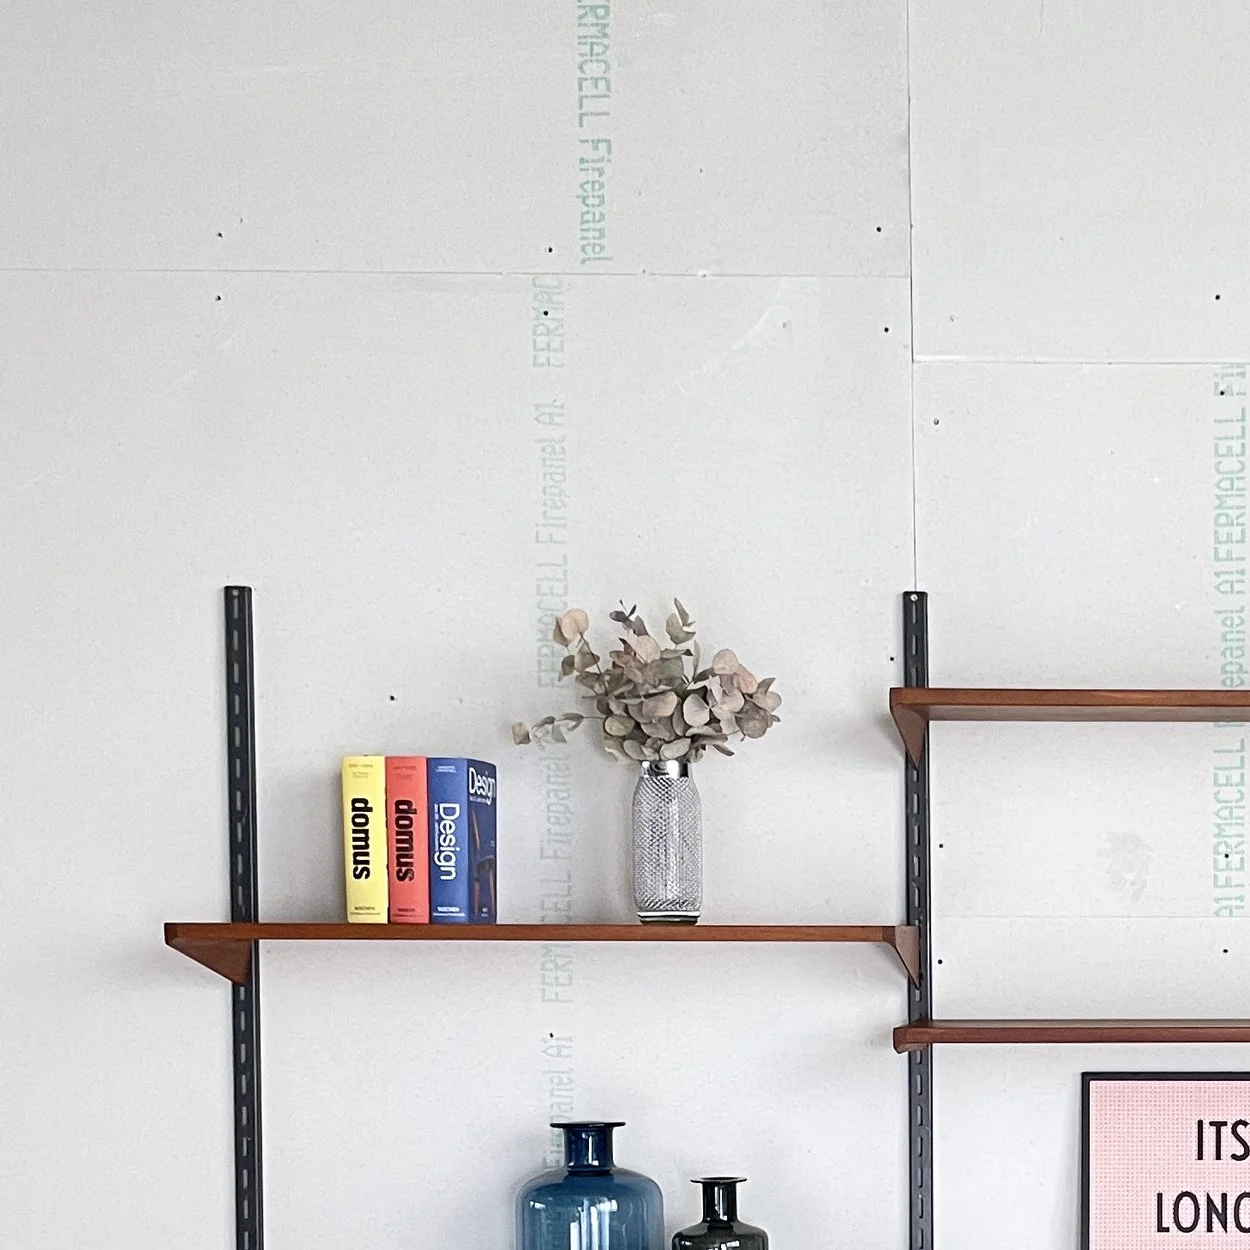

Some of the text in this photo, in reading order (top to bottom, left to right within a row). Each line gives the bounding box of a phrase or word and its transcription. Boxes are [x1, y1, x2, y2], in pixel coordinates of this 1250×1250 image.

[577, 0, 612, 265] RMACELL Firepanel
[534, 437, 571, 545] Firepanel
[468, 767, 497, 805] Design
[539, 754, 575, 861] Firepanel
[351, 797, 373, 880] domus
[395, 799, 417, 882] domus
[434, 803, 460, 881] Design
[1196, 1119, 1250, 1161] ITS
